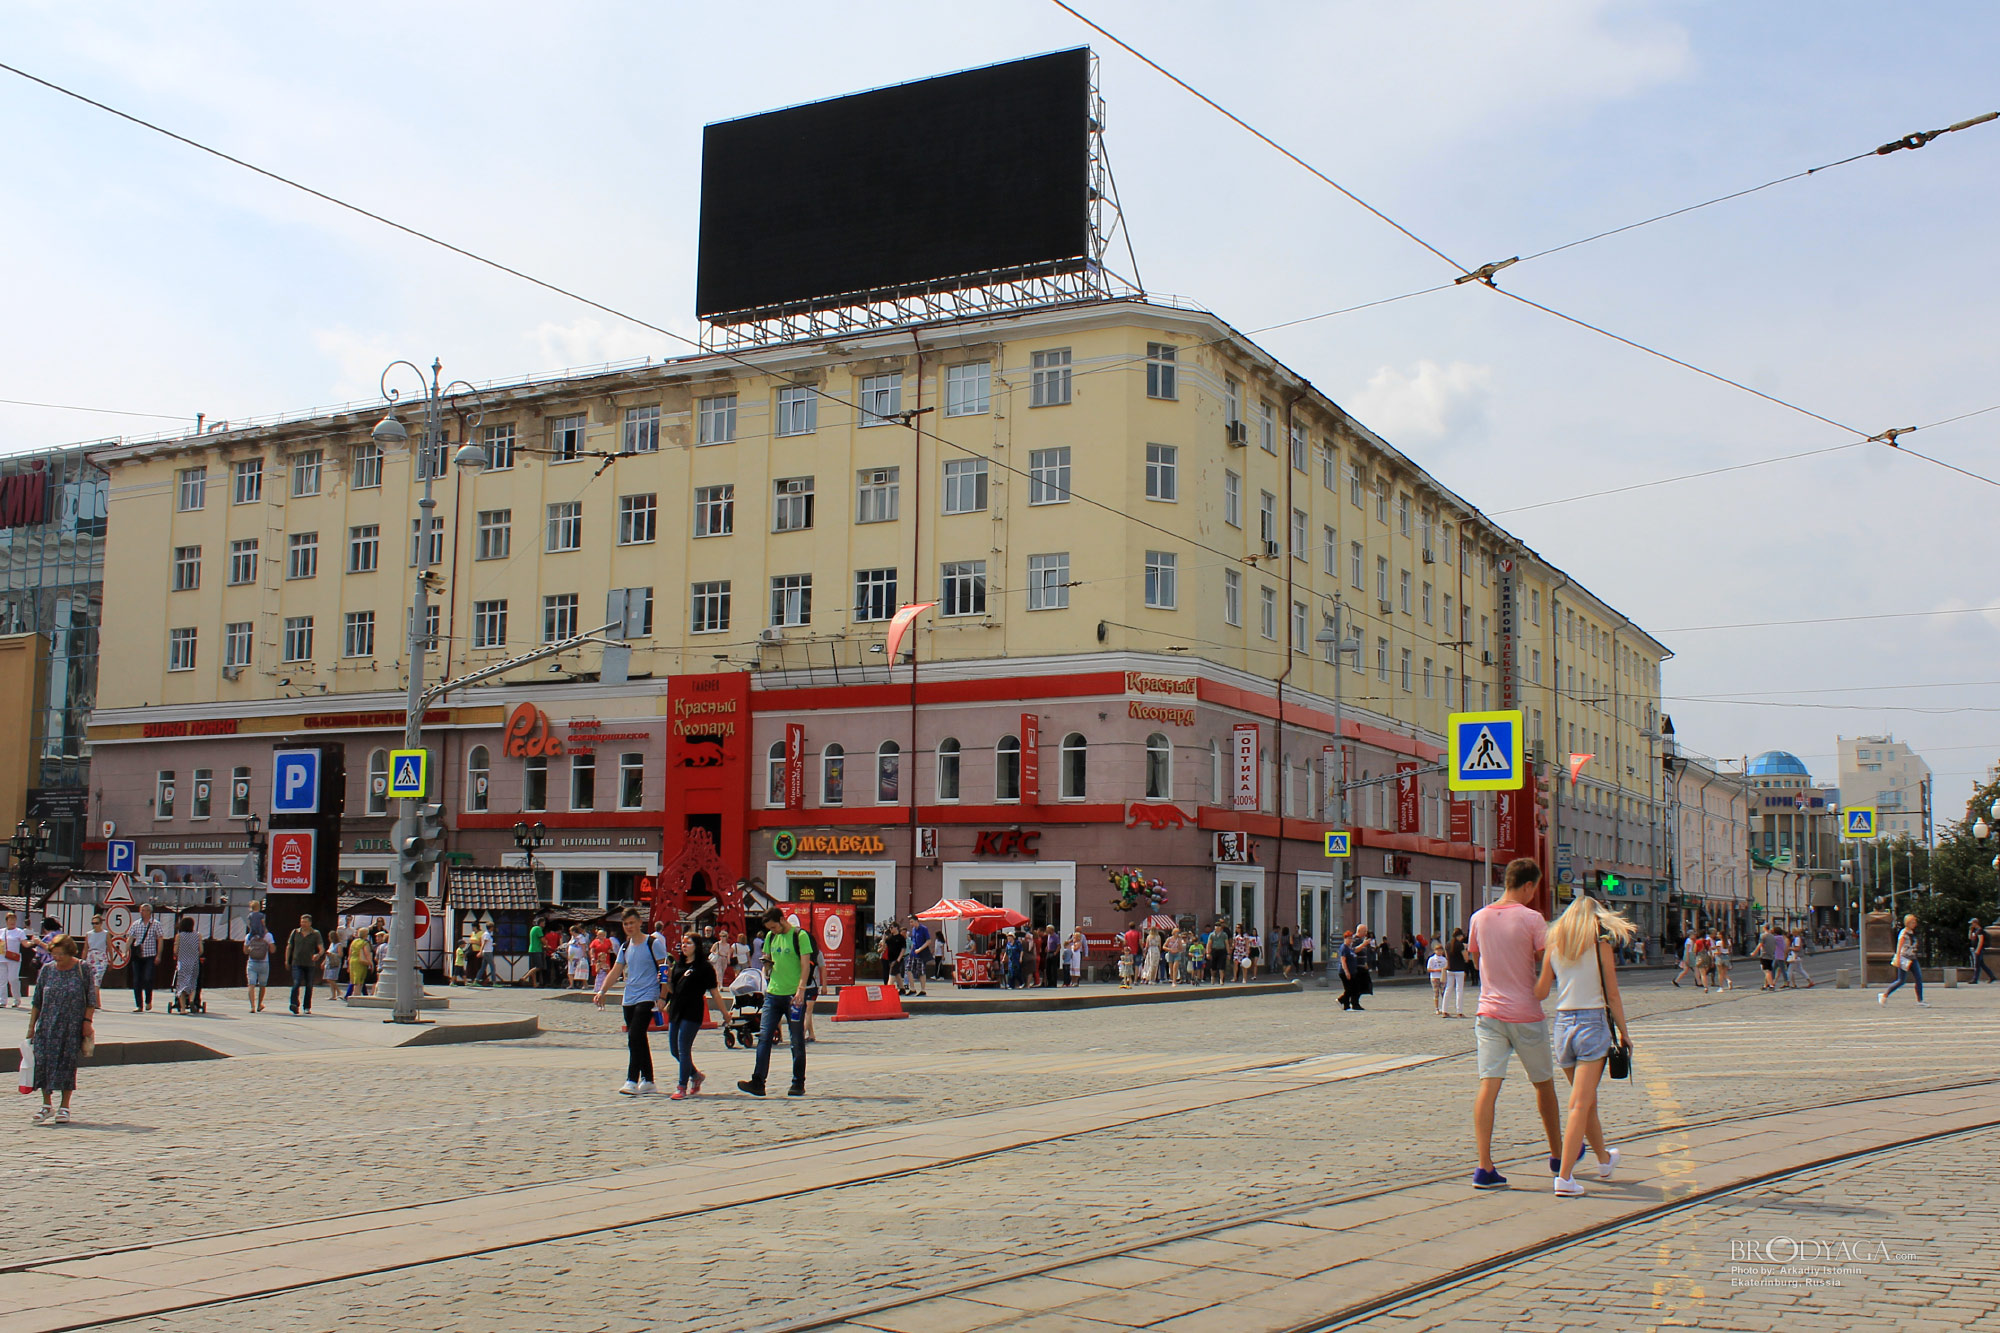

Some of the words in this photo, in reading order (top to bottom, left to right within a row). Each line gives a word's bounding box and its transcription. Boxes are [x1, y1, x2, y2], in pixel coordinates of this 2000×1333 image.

[1502, 577, 1512, 708] ТЯЖПРОМЭЛЕКТРОМЕ
[1127, 671, 1195, 694] Красный
[674, 698, 736, 719] Красный
[1128, 701, 1195, 727] Леопард
[502, 702, 563, 757] Рада
[673, 720, 735, 738] Леопард
[1240, 737, 1251, 791] ОПТИКА
[285, 764, 307, 800] P
[353, 838, 391, 850] АПТЕ
[561, 838, 611, 847] ЦЕНТРАЛЬНАЯ
[619, 838, 647, 846] АПТЕКА
[797, 835, 884, 855] МЕДВЕДЬ
[972, 831, 1041, 855] KFC
[113, 844, 129, 868] P
[273, 876, 309, 885] АВТОМОЙКА
[115, 914, 122, 927] 5
